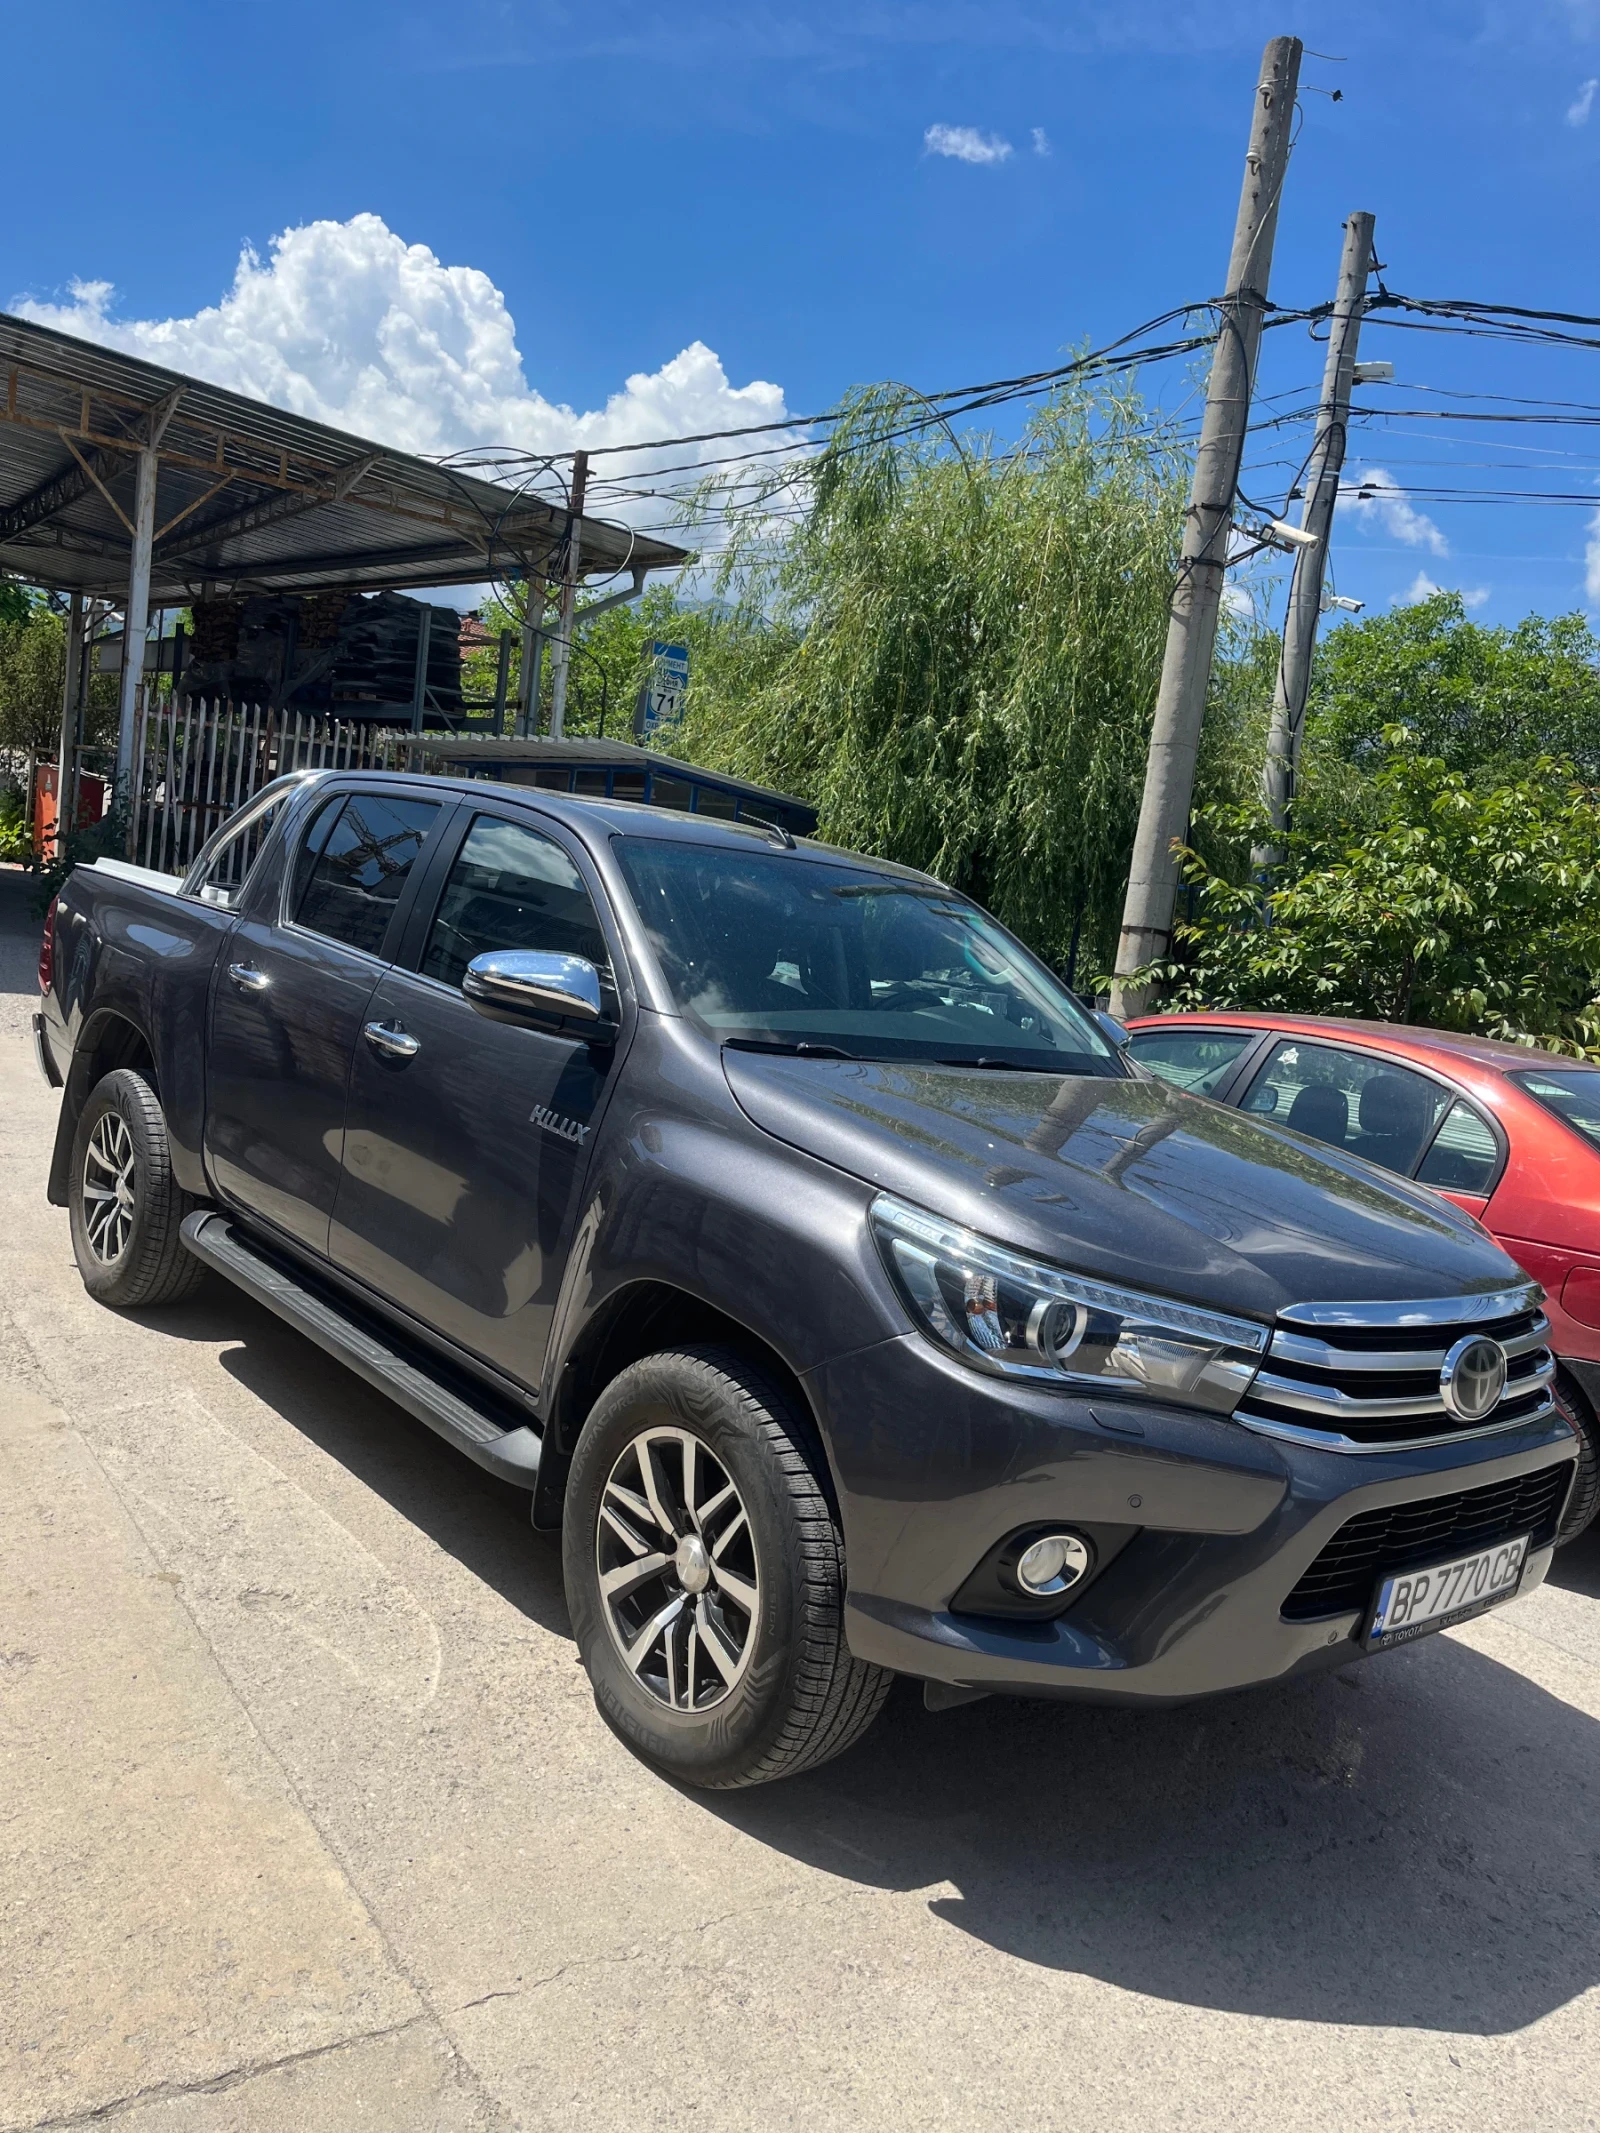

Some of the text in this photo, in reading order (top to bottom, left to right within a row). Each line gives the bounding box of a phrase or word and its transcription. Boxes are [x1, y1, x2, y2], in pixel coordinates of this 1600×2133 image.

[656, 693, 675, 712] 71
[529, 1104, 591, 1146] HILUX
[1393, 1625, 1423, 1642] TOYOTA
